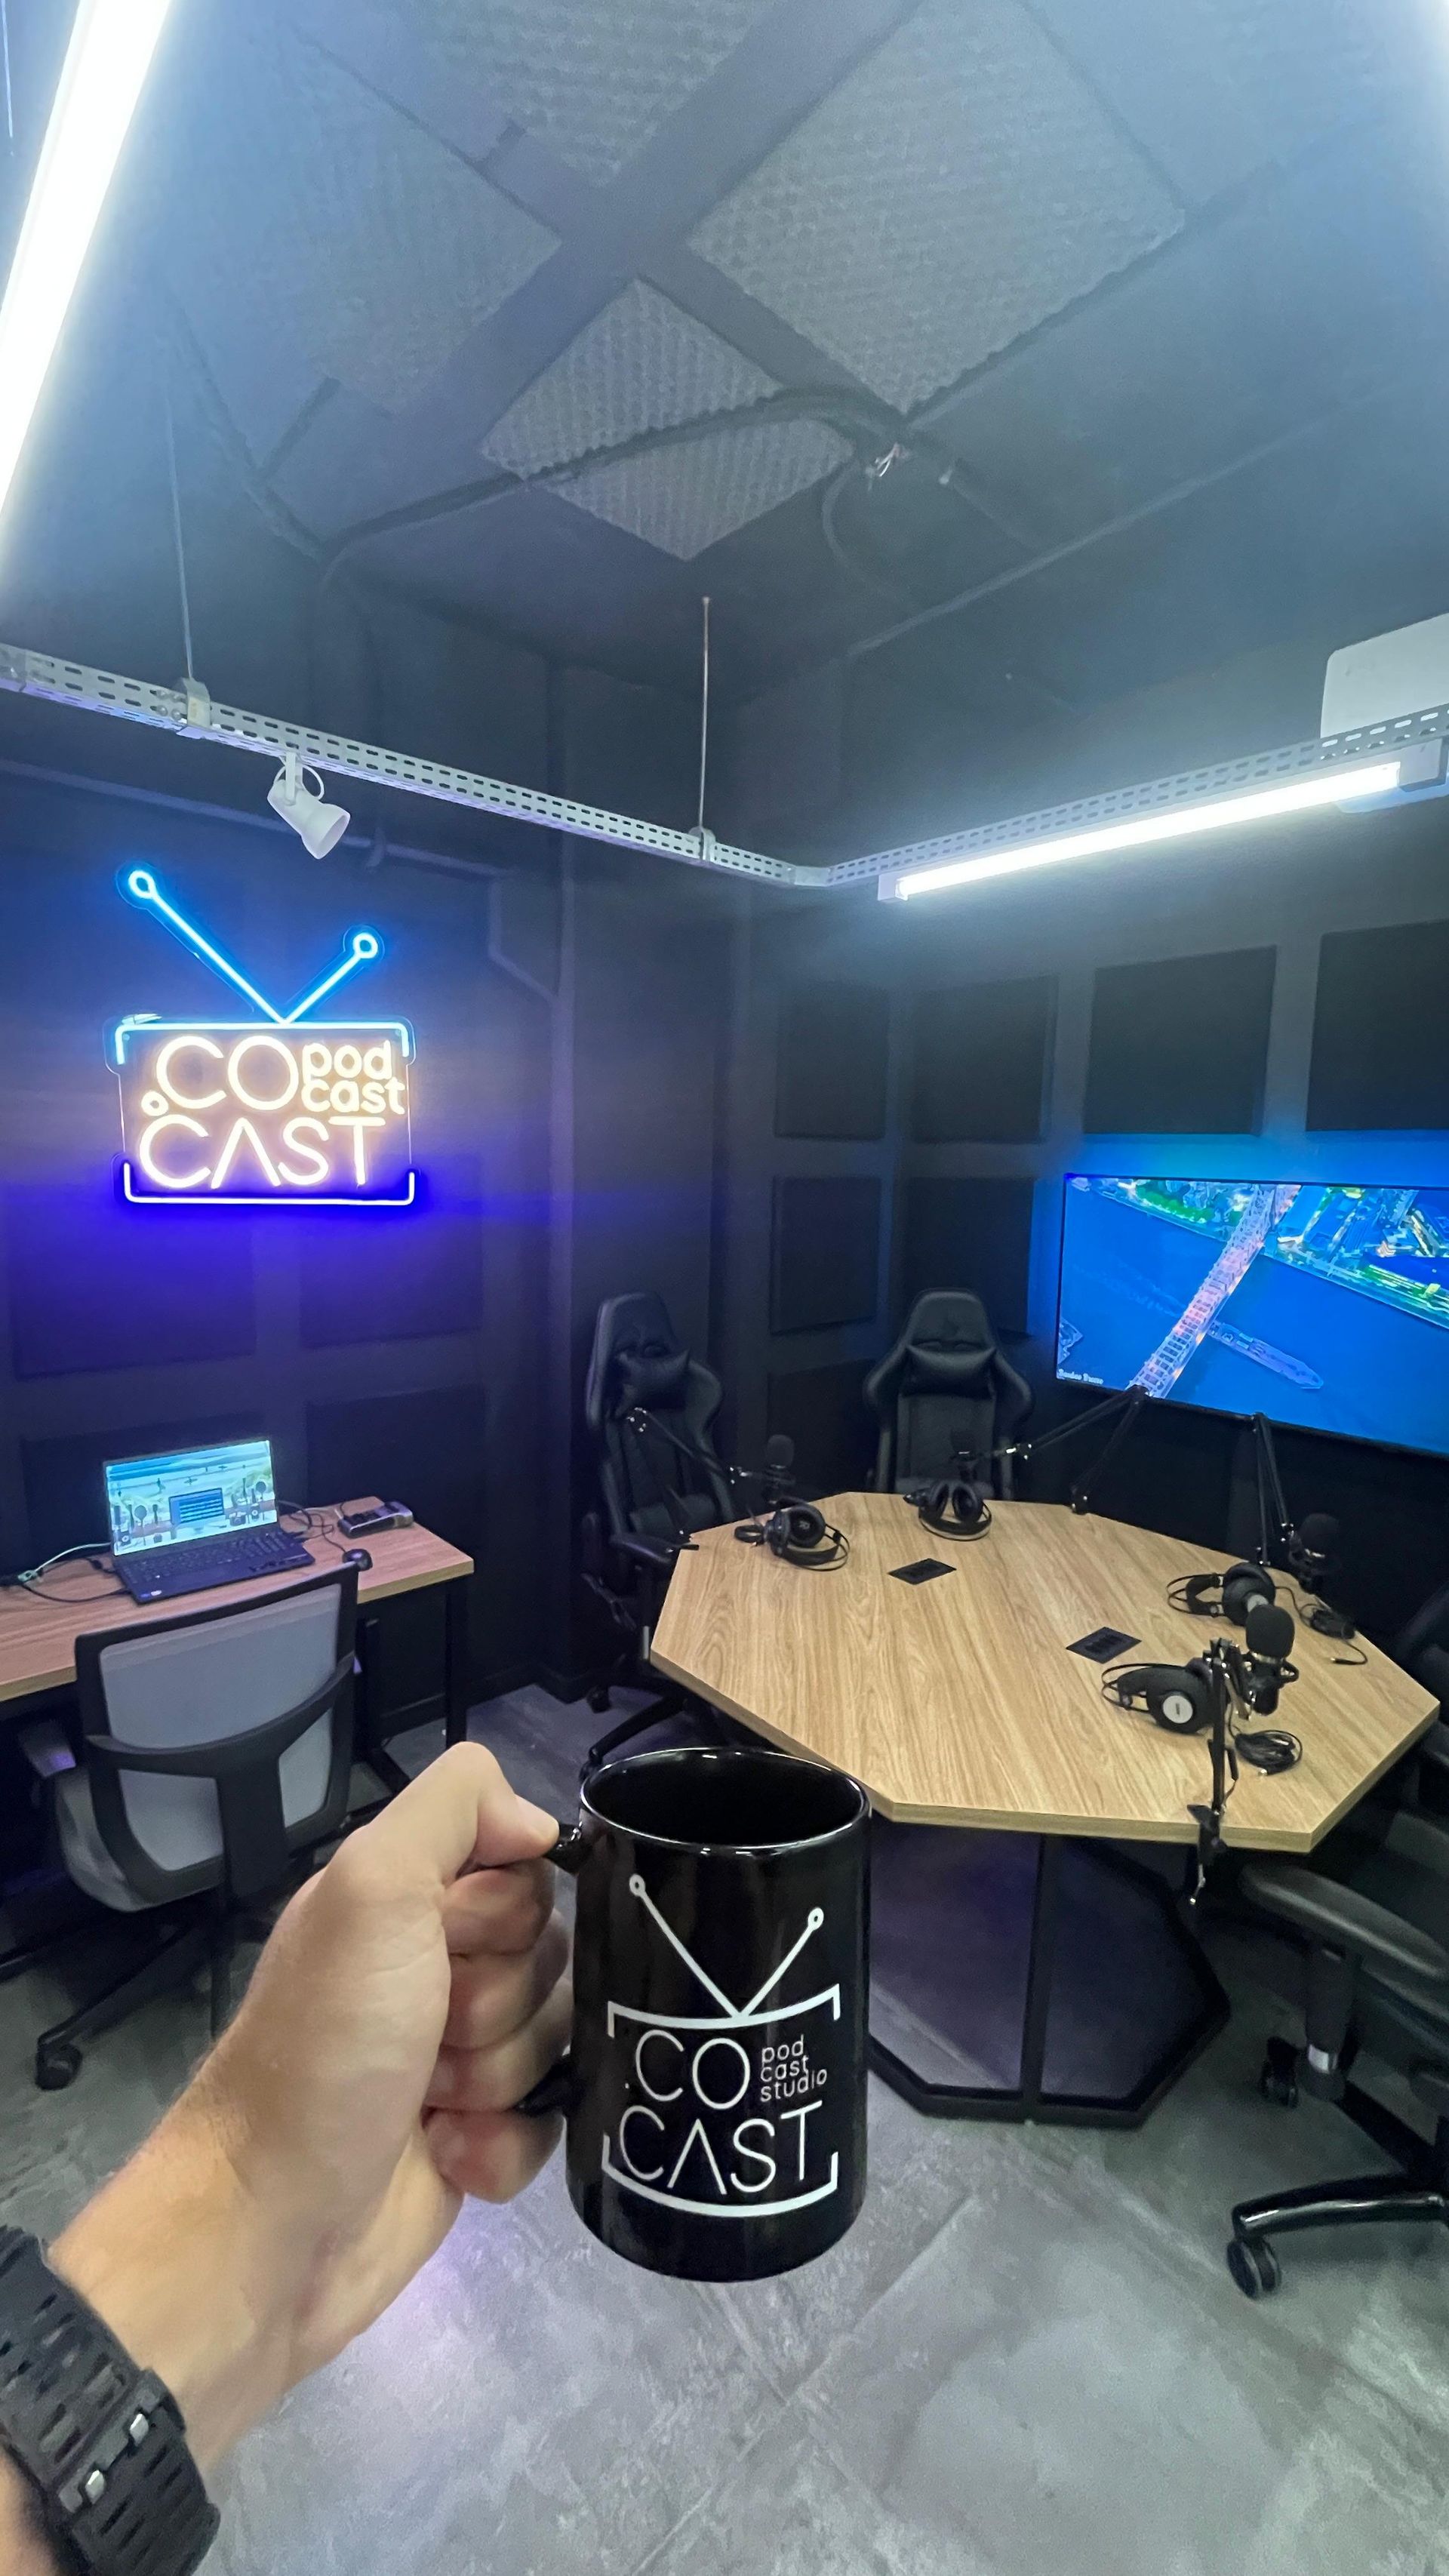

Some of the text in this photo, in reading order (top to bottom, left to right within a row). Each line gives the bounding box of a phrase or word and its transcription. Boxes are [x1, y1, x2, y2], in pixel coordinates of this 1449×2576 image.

[303, 1040, 392, 1085] pod
[301, 1077, 405, 1115] cast
[140, 1114, 386, 1189] CAST
[760, 2054, 809, 2082] cast
[761, 2034, 804, 2068] pod
[760, 2069, 828, 2103] studio
[619, 2100, 823, 2195] CAST
